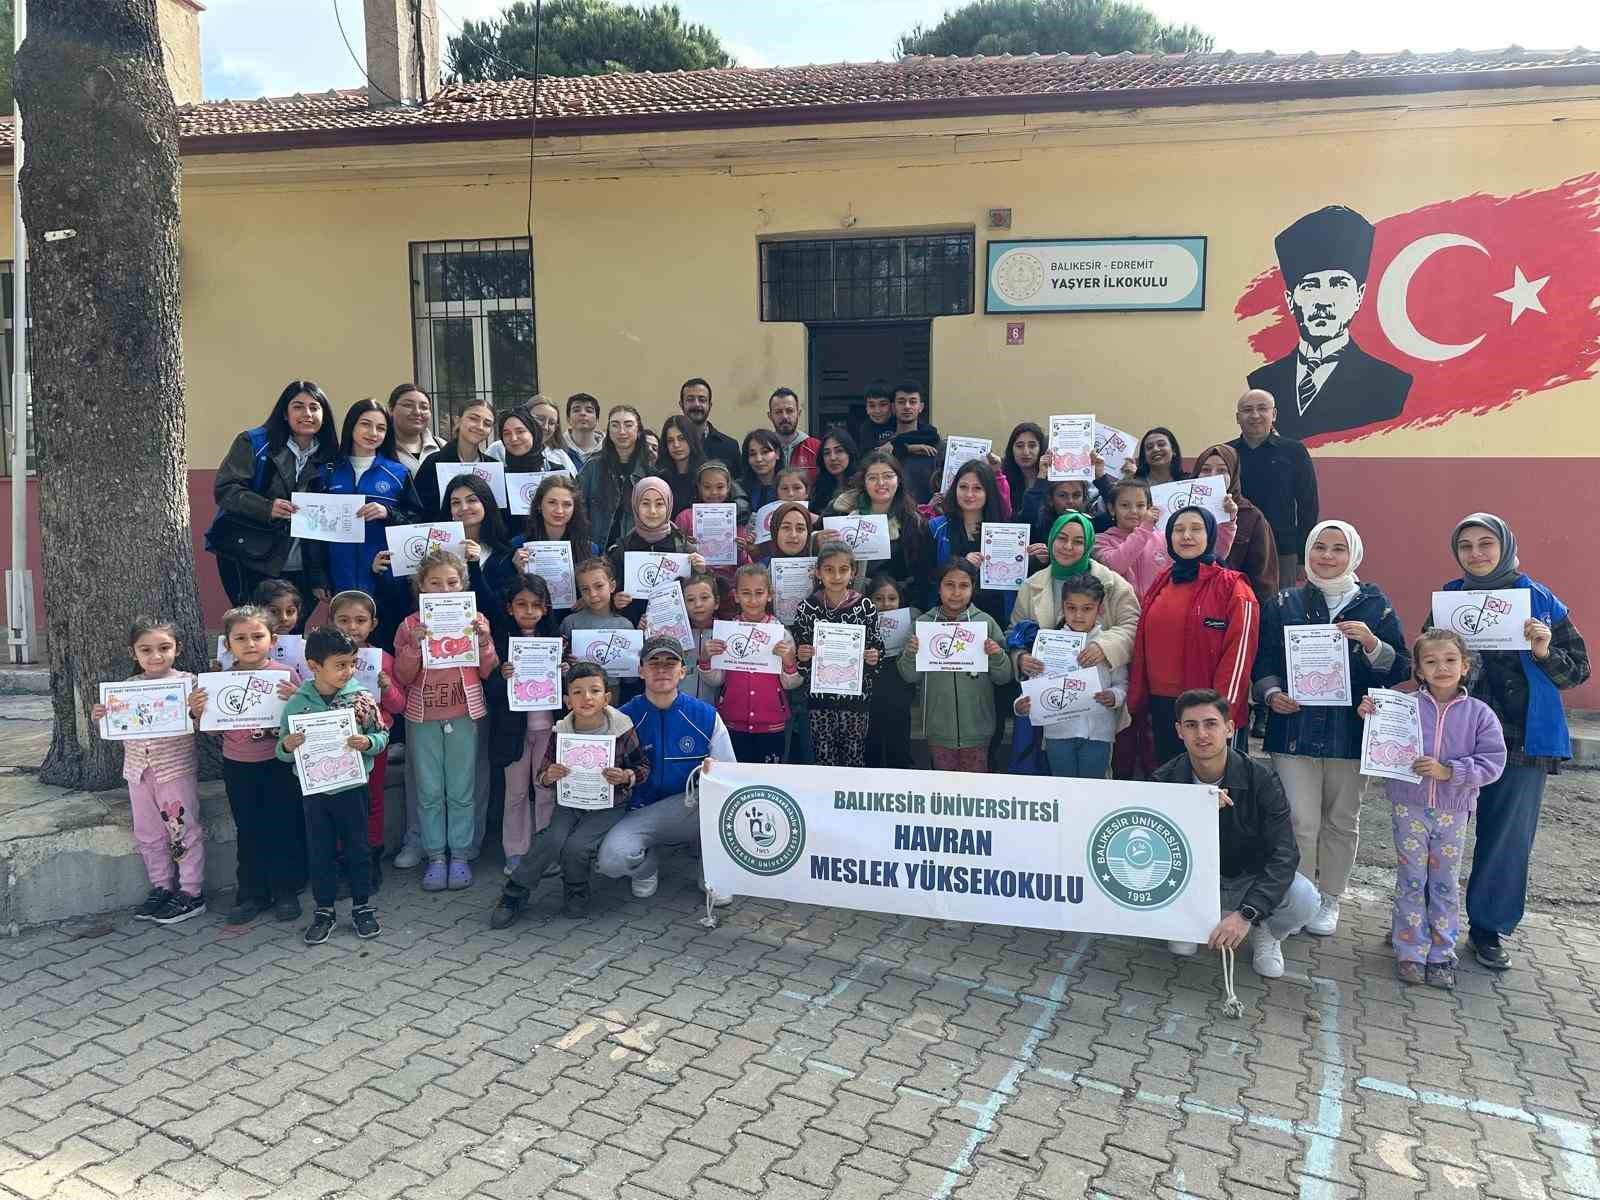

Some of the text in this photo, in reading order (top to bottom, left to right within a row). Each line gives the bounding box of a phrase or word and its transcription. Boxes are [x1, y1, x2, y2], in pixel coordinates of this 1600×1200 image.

[1050, 259, 1101, 271] BALIKESİR
[1111, 260, 1153, 270] EDREMİT
[1051, 275, 1168, 290] YAŞYER İLKOKULU
[834, 792, 1059, 822] BALIKESİR ÜNİVERSİTESİ
[895, 825, 991, 856] HAVRAN
[1096, 815, 1183, 872] BALIKESİR ÜNİVERSİTESİ
[810, 855, 1084, 904] MESLEK YÜKSEKOKULU
[1128, 891, 1152, 902] 1992
